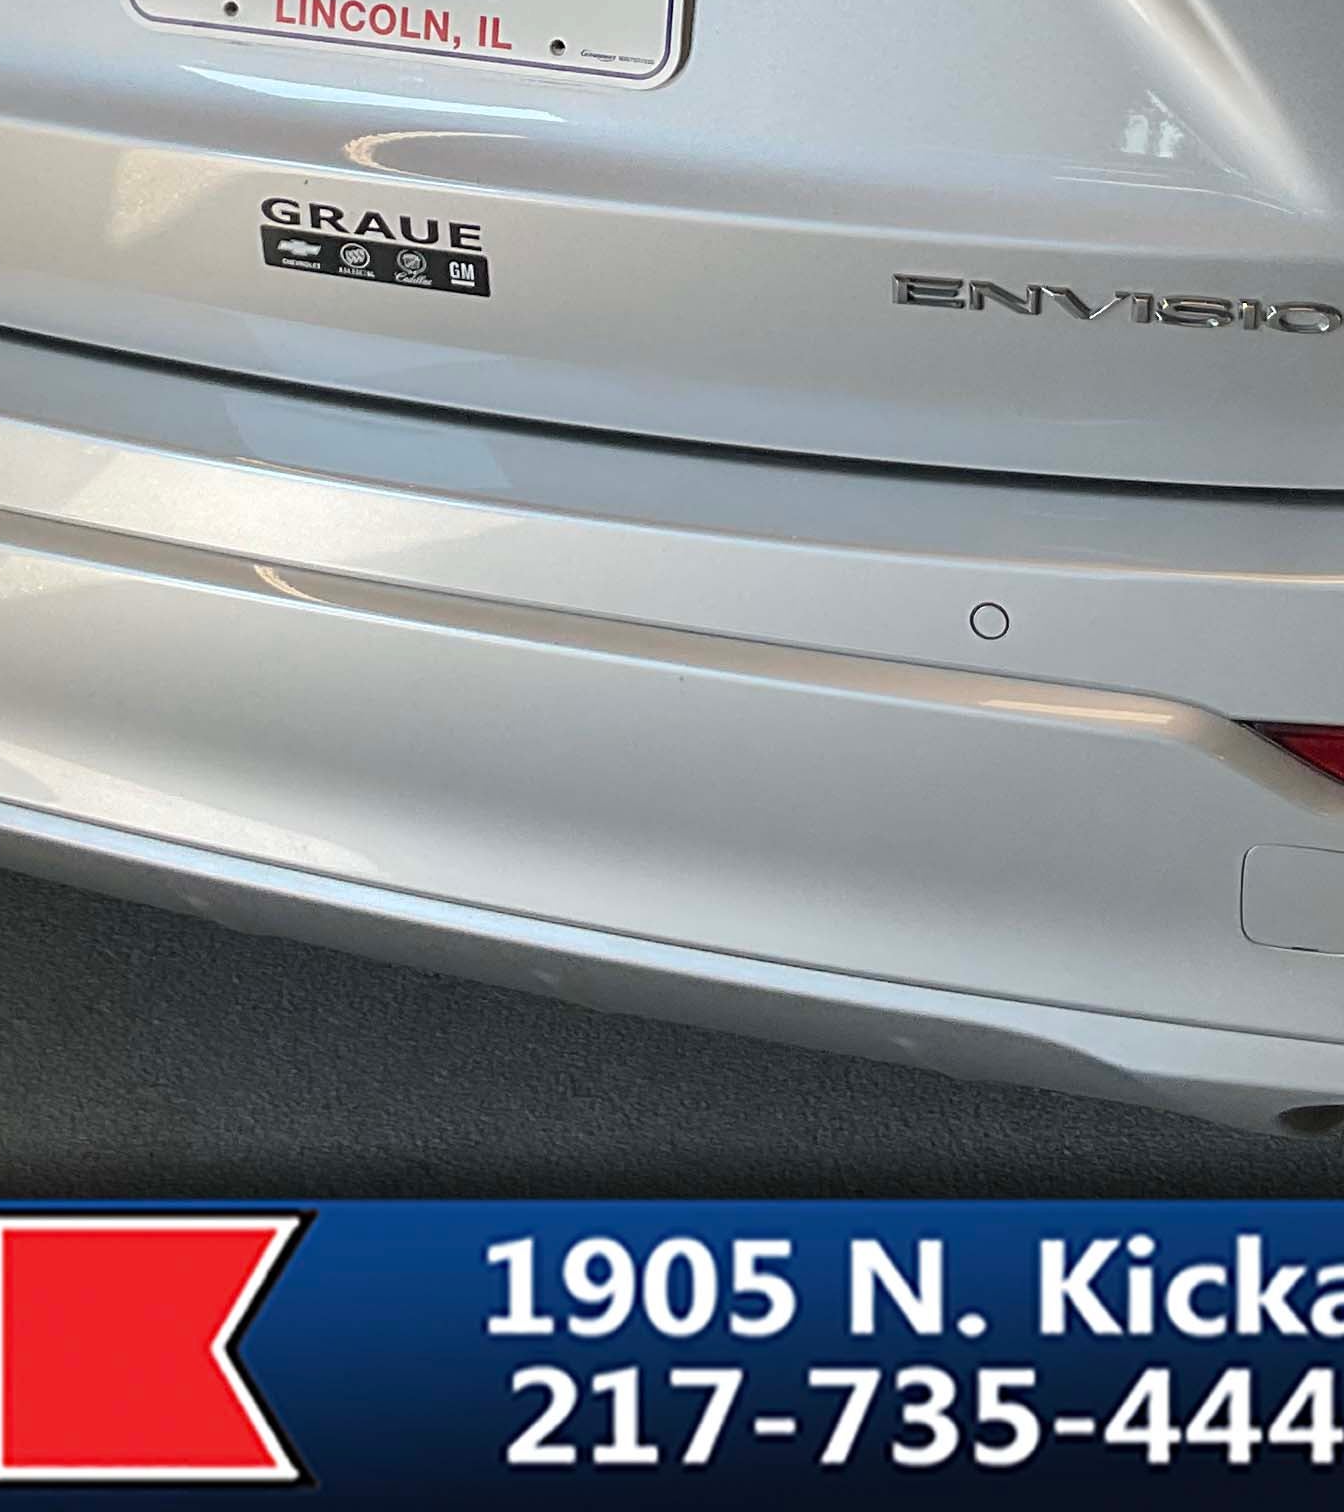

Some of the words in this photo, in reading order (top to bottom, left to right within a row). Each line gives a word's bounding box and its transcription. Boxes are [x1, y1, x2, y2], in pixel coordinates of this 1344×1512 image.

[478, 15, 512, 50] IL
[261, 197, 483, 251] GRAUE
[449, 261, 475, 287] GM
